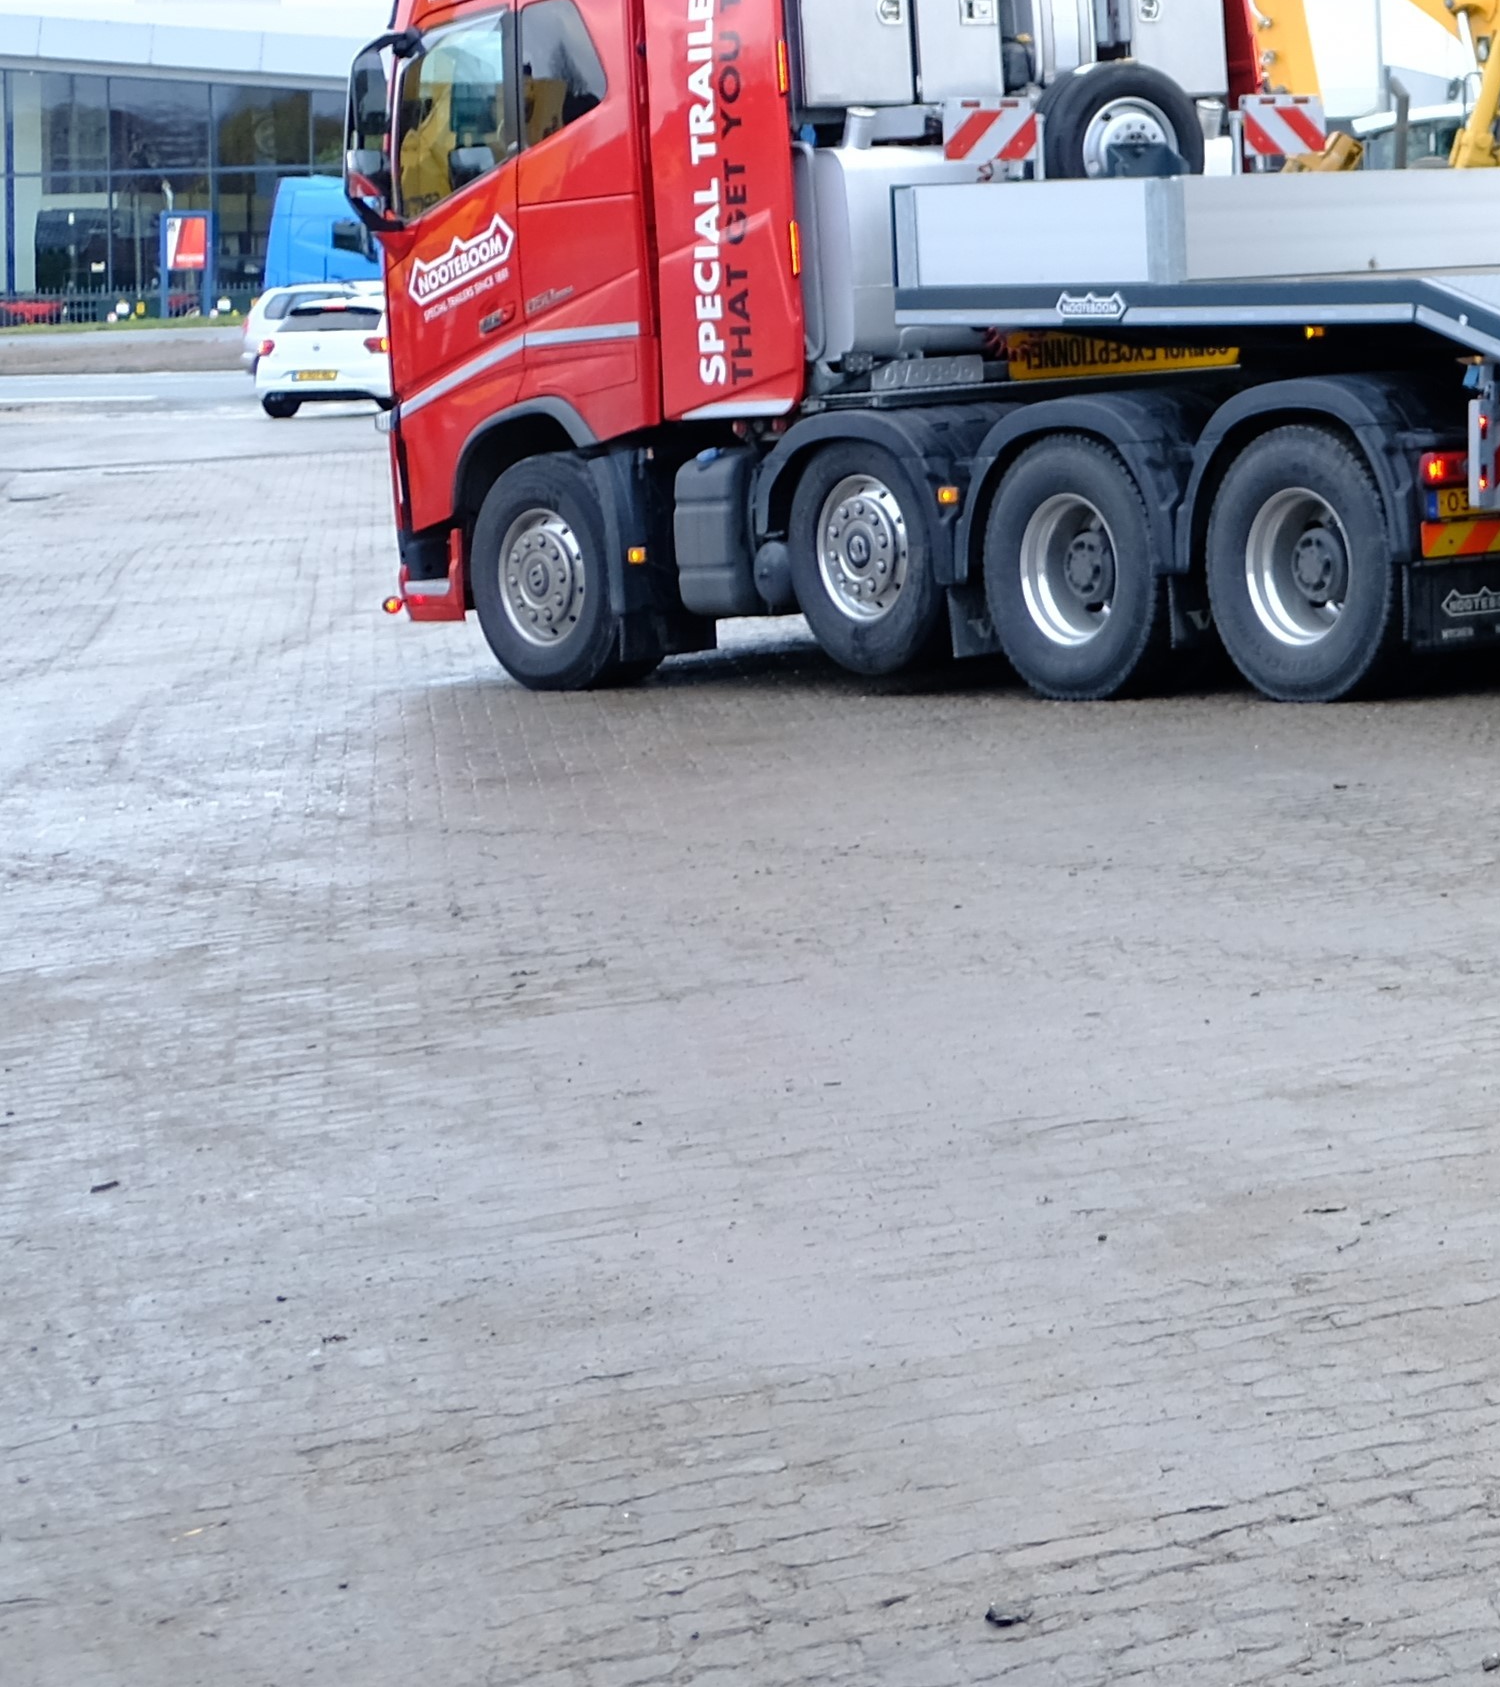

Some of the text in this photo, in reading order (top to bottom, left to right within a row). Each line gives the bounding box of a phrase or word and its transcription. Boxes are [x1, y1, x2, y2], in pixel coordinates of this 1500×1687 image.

[718, 29, 743, 141] YOU
[724, 158, 749, 245] GET
[417, 232, 504, 297] NOOTEBOOM
[693, 176, 727, 387] SPECIAL
[1061, 301, 1119, 314] NOOTEBOOM
[726, 263, 754, 385] THAT
